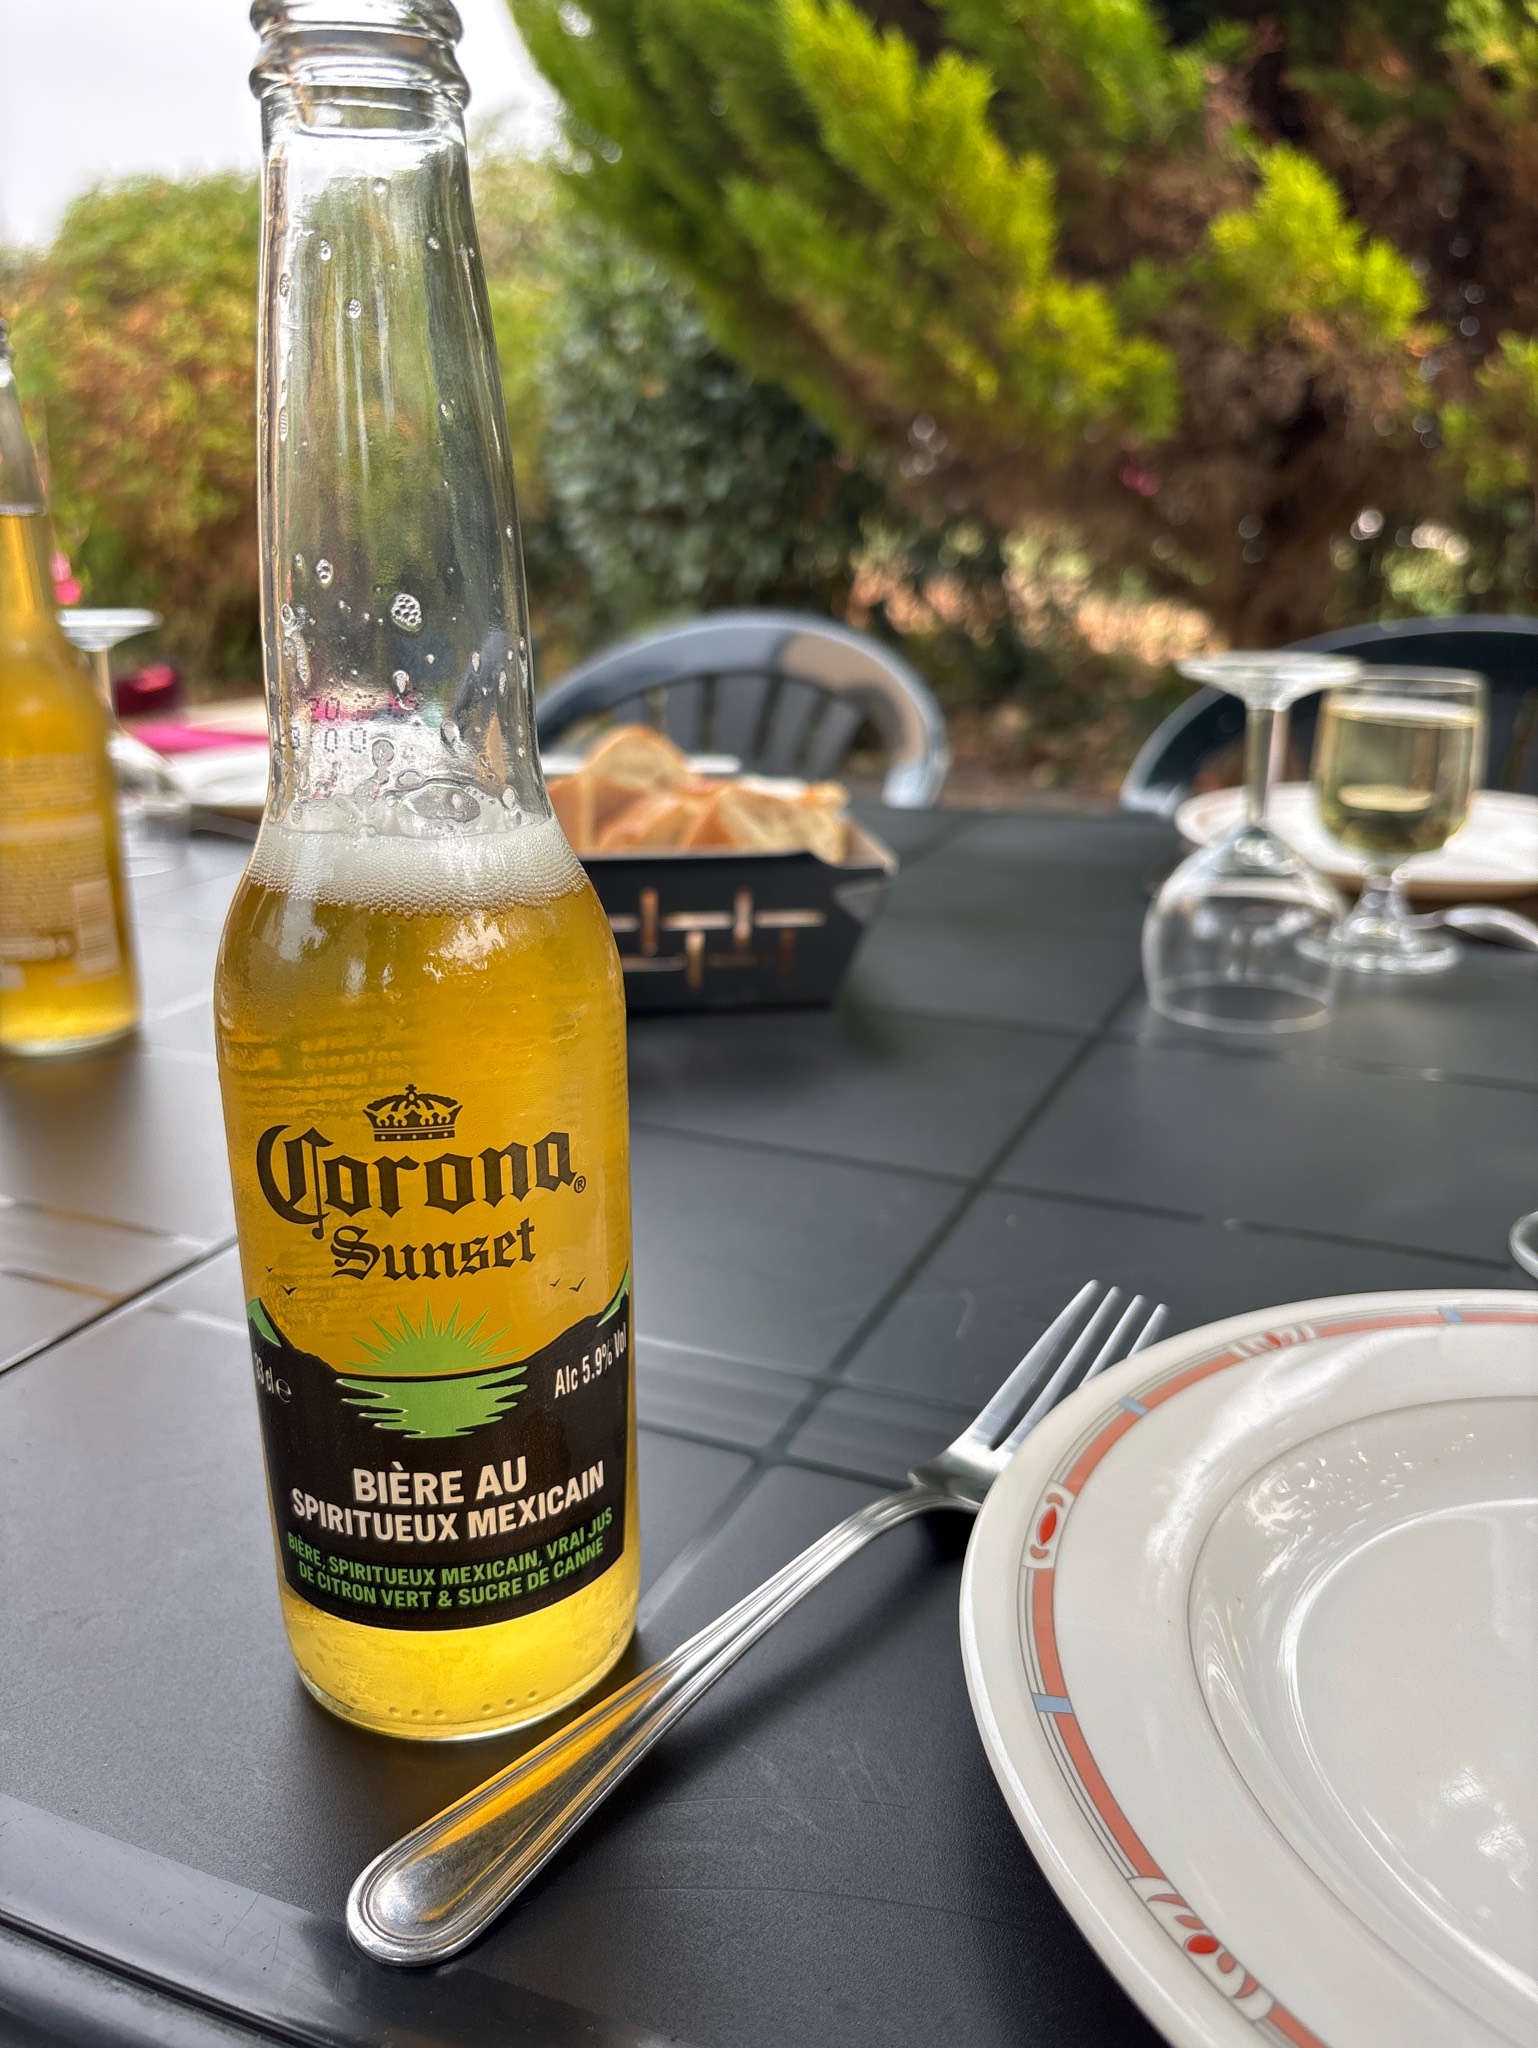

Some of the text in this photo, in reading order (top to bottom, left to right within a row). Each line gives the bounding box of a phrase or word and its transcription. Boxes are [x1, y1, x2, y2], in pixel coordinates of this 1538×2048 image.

[330, 1217, 536, 1281] Sunset
[553, 1320, 627, 1399] Alc 5.9% Vol
[290, 1459, 606, 1543] SPIRITUEUX MEXICAIN
[352, 1455, 528, 1506] BIÈRE AU
[287, 1506, 614, 1586] BIÈRE, SPIRITUEUX MEXICAIN, VRAI JUS
[298, 1535, 605, 1609] DE CITRON VERT & SUCRE DE CANNE
